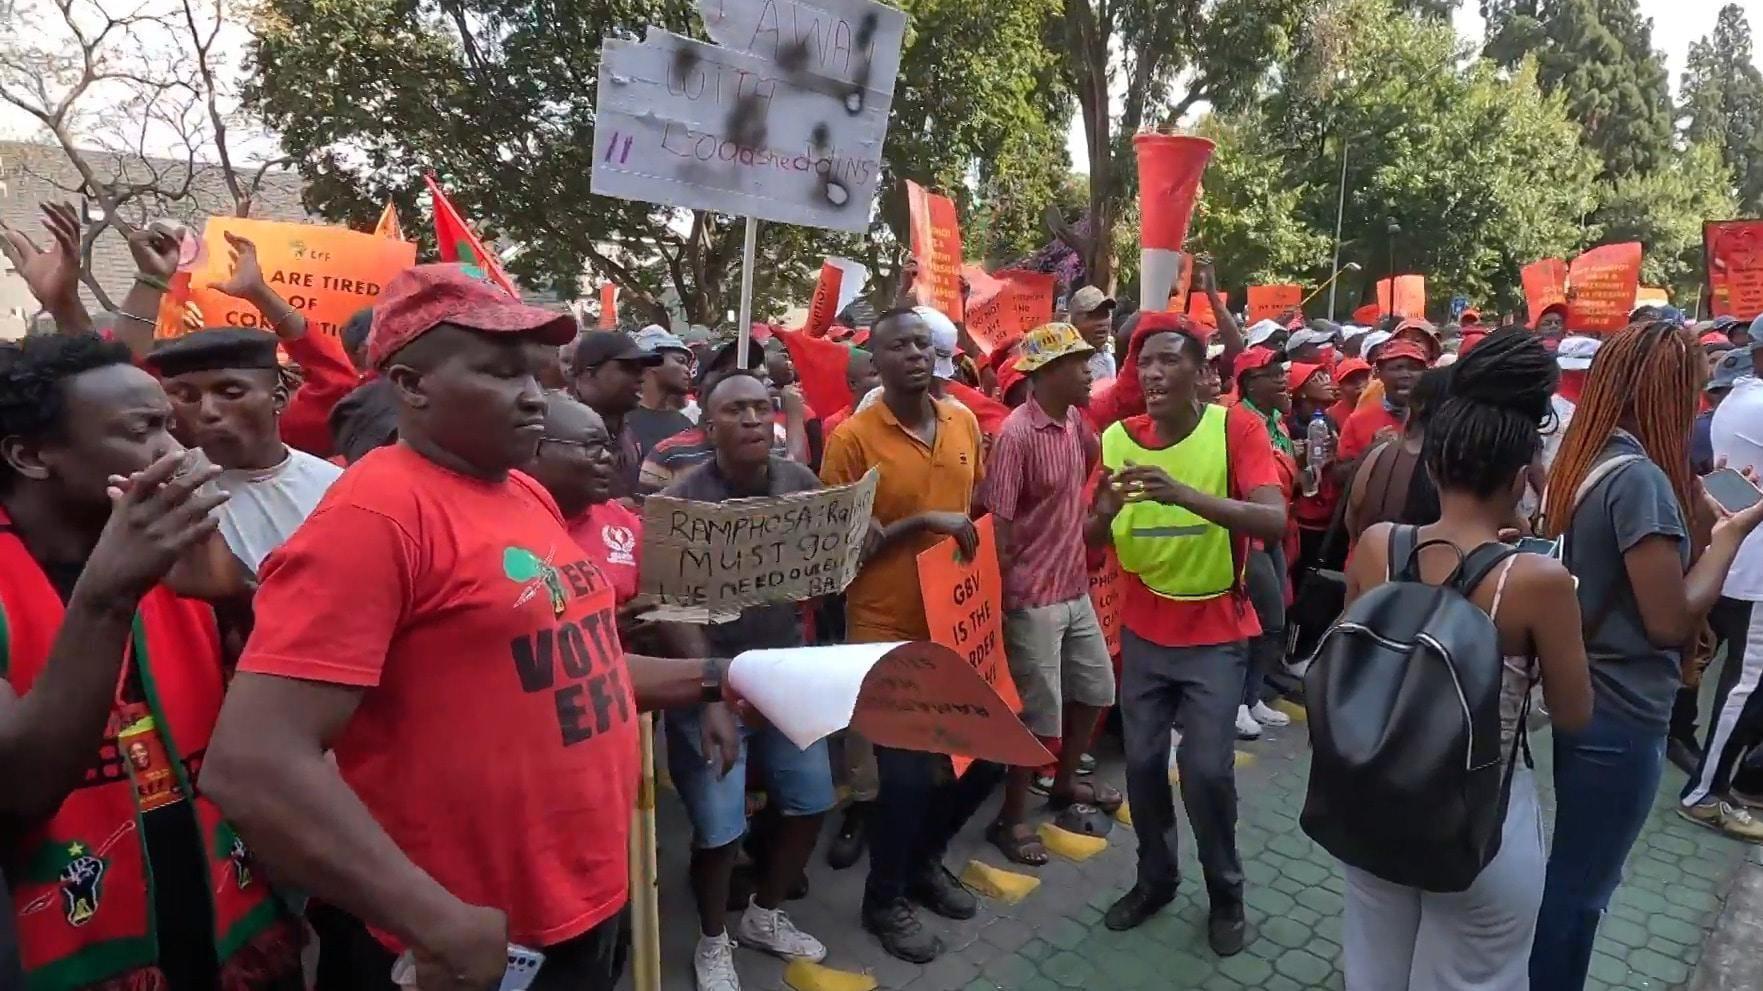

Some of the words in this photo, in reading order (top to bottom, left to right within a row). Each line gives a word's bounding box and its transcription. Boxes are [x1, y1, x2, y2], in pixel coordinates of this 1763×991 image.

[270, 270, 314, 288] ARE
[322, 275, 381, 297] TIRED
[288, 294, 318, 311] OF
[679, 541, 787, 577] MUST
[953, 570, 980, 606] GBV
[952, 620, 968, 646] IS
[969, 600, 992, 632] THE
[968, 630, 995, 668] RDER
